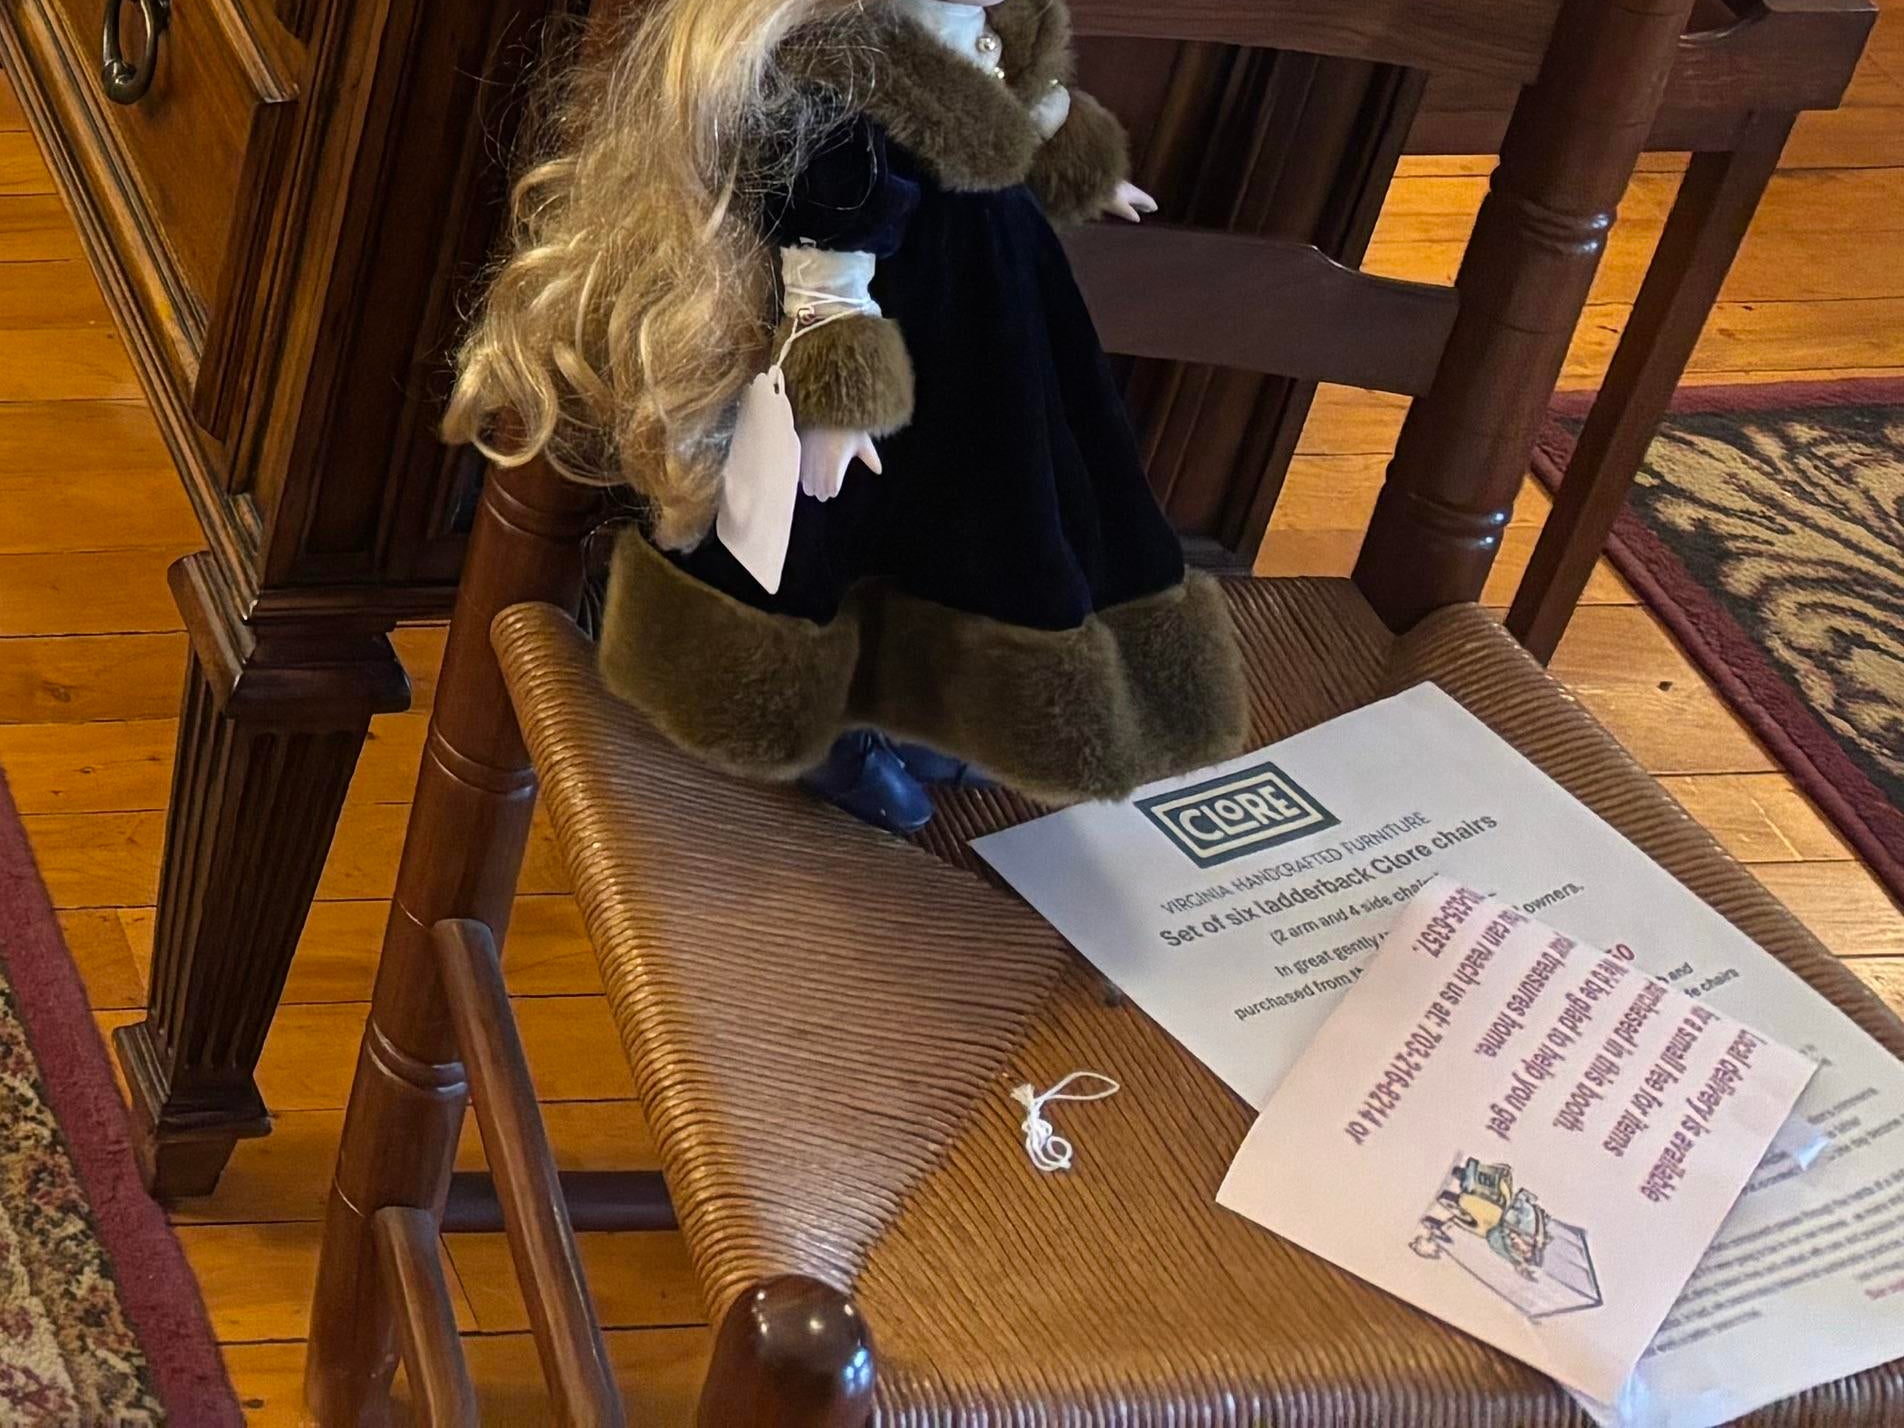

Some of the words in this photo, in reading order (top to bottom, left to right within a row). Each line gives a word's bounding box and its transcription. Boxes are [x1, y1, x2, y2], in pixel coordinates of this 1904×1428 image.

[1178, 786, 1302, 841] CLORE
[1159, 923, 1203, 946] Set
[1203, 914, 1226, 934] of
[1226, 907, 1261, 926] six
[1254, 867, 1376, 915] ladderback
[1370, 842, 1433, 875] Clore
[1431, 815, 1498, 850] chairs
[1160, 885, 1235, 914] VIRGINIA
[1231, 847, 1343, 892] HANDCRAFTED
[1339, 811, 1432, 855] FURNITURE
[1270, 929, 1288, 945] (2
[1289, 919, 1320, 938] arm
[1319, 907, 1349, 926] and
[1349, 905, 1361, 917] 4
[1360, 895, 1393, 913] side
[1481, 914, 1511, 947] can
[1274, 965, 1293, 977] In
[1293, 947, 1334, 975] great
[1333, 935, 1380, 962] gently
[1453, 941, 1494, 986] reach
[1668, 962, 1694, 981] and
[1234, 984, 1315, 1021] purchased
[1313, 973, 1351, 994] from
[1439, 982, 1466, 1005] us
[1506, 952, 1566, 1016] treasures
[1579, 978, 1612, 1001] be
[1700, 968, 1740, 991] chairs
[1424, 1002, 1451, 1027] at:
[1473, 1011, 1525, 1057] home.
[1558, 992, 1592, 1037] glad
[1613, 981, 1668, 1048] purchased
[1683, 1018, 1703, 1032] a
[1546, 1027, 1576, 1047] to
[1603, 1038, 1634, 1058] in
[1660, 1027, 1698, 1074] small
[1726, 1029, 1768, 1069] Local
[1357, 1024, 1443, 1128] 703-216-8214
[1520, 1043, 1566, 1080] help
[1584, 1054, 1620, 1087] this
[1645, 1064, 1679, 1092] fee
[1504, 1071, 1538, 1112] you
[1552, 1082, 1606, 1132] booth.
[1630, 1086, 1664, 1117] for
[1685, 1059, 1744, 1122] delivery
[1344, 1121, 1370, 1142] or
[1485, 1103, 1517, 1141] get
[1602, 1109, 1650, 1157] items
[1681, 1115, 1712, 1136] is
[1640, 1131, 1694, 1202] available
